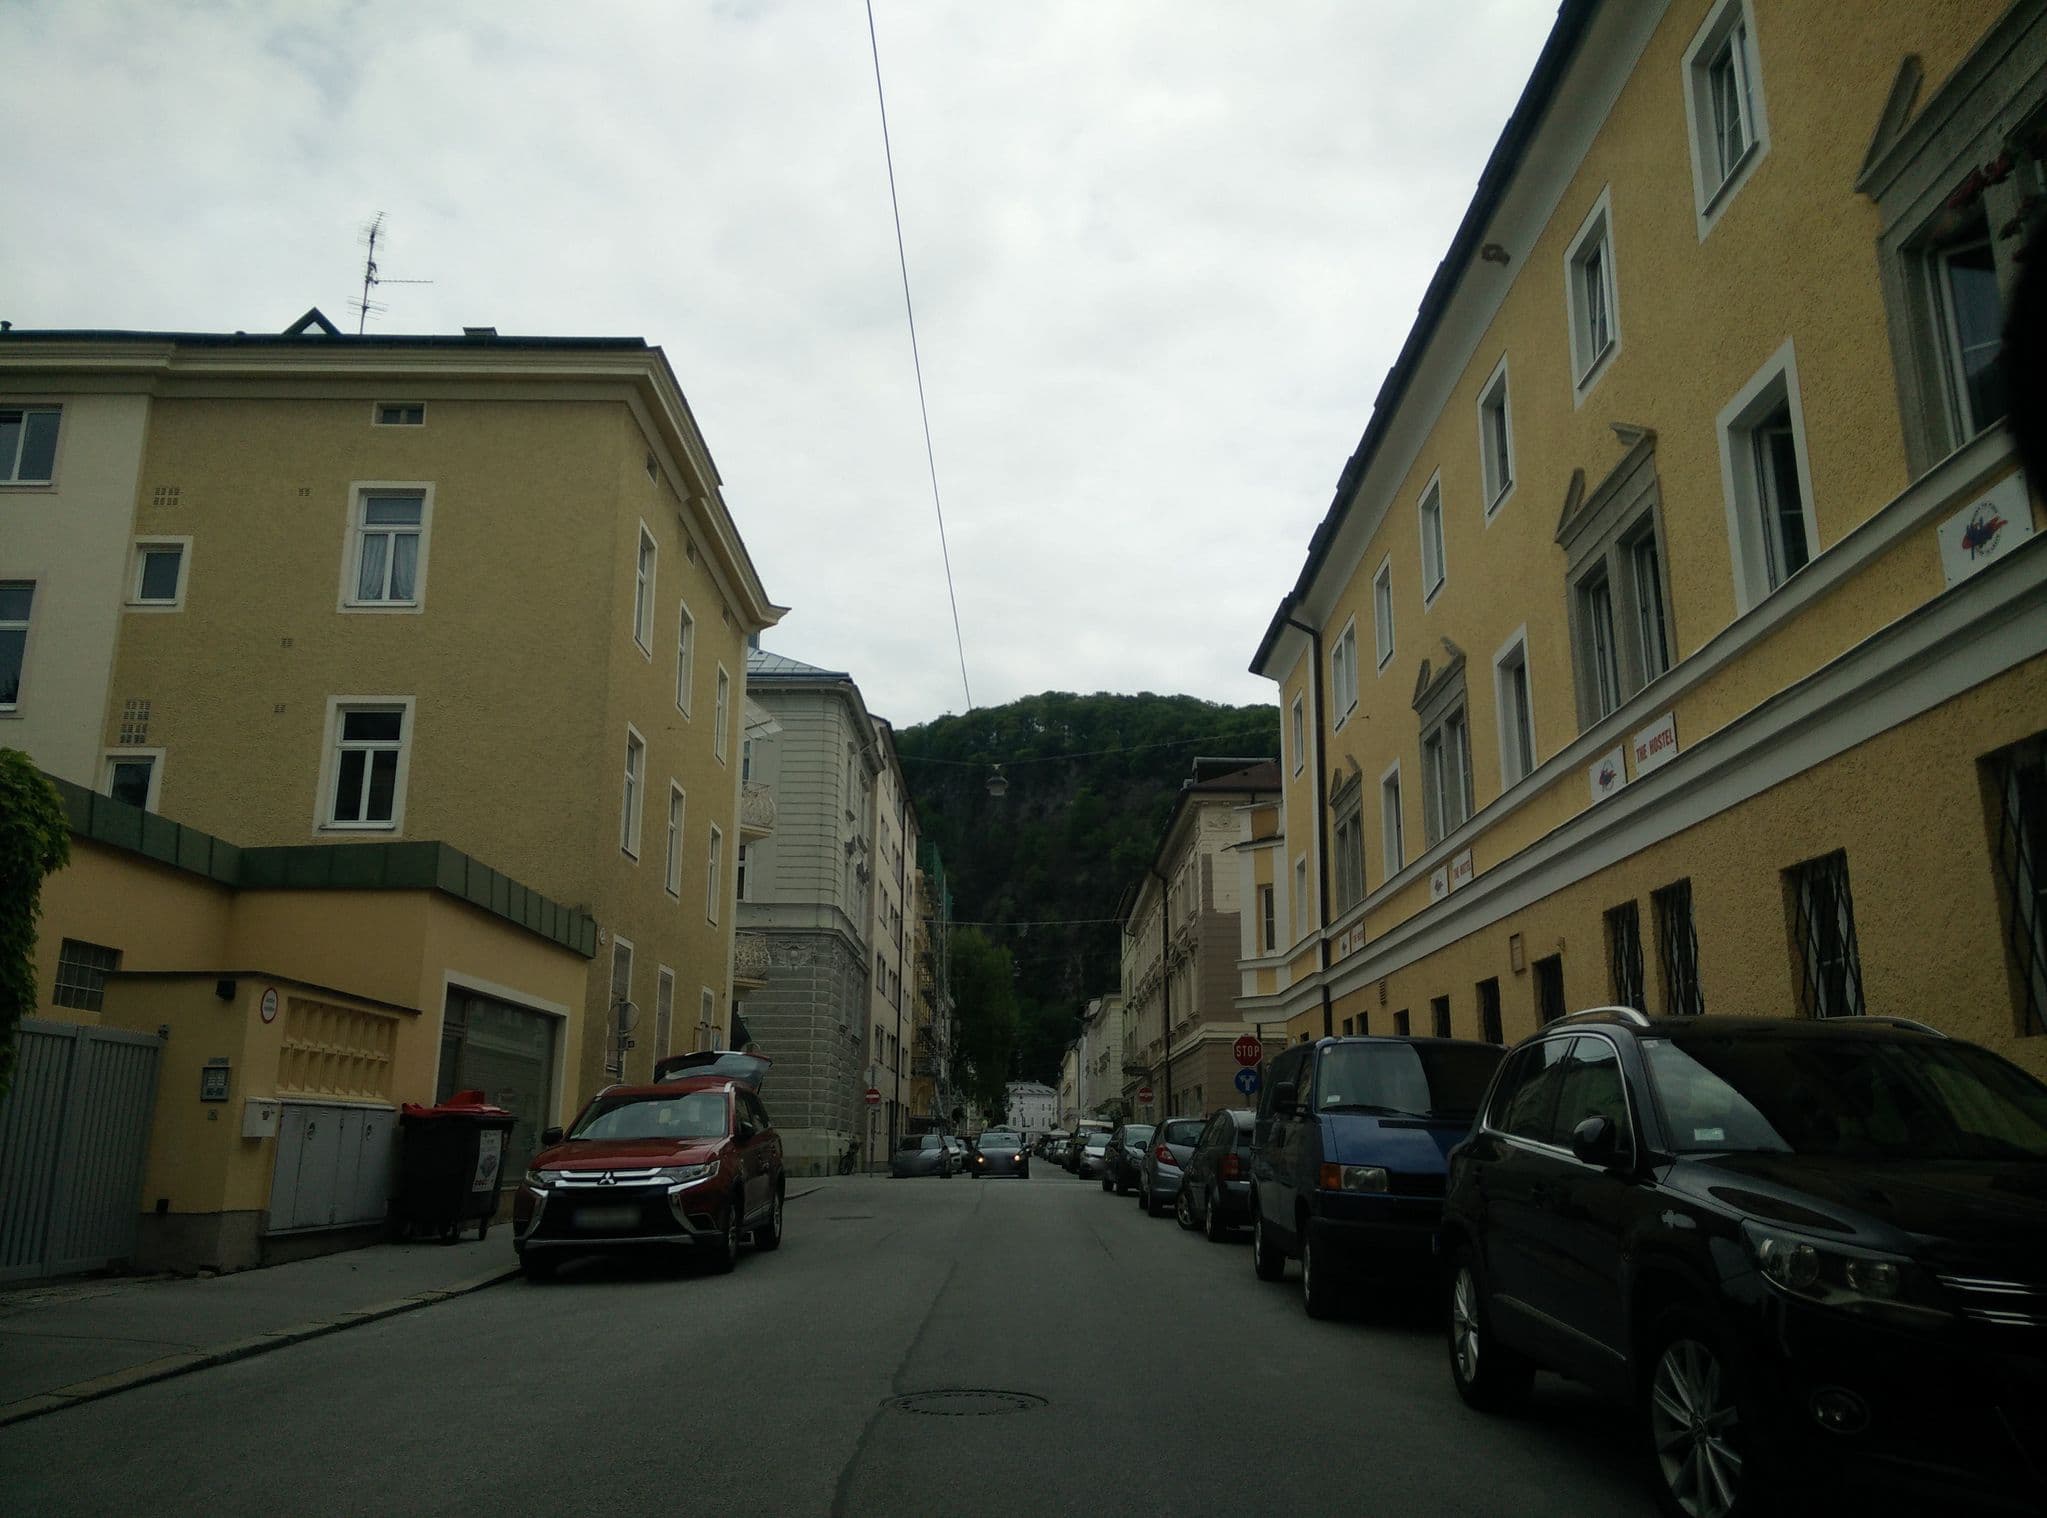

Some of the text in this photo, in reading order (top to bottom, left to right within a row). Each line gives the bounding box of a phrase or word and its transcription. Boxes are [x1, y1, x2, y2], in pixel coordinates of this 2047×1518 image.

[1636, 728, 1674, 763] THE HOSTEL
[1235, 1045, 1260, 1057] STOP
